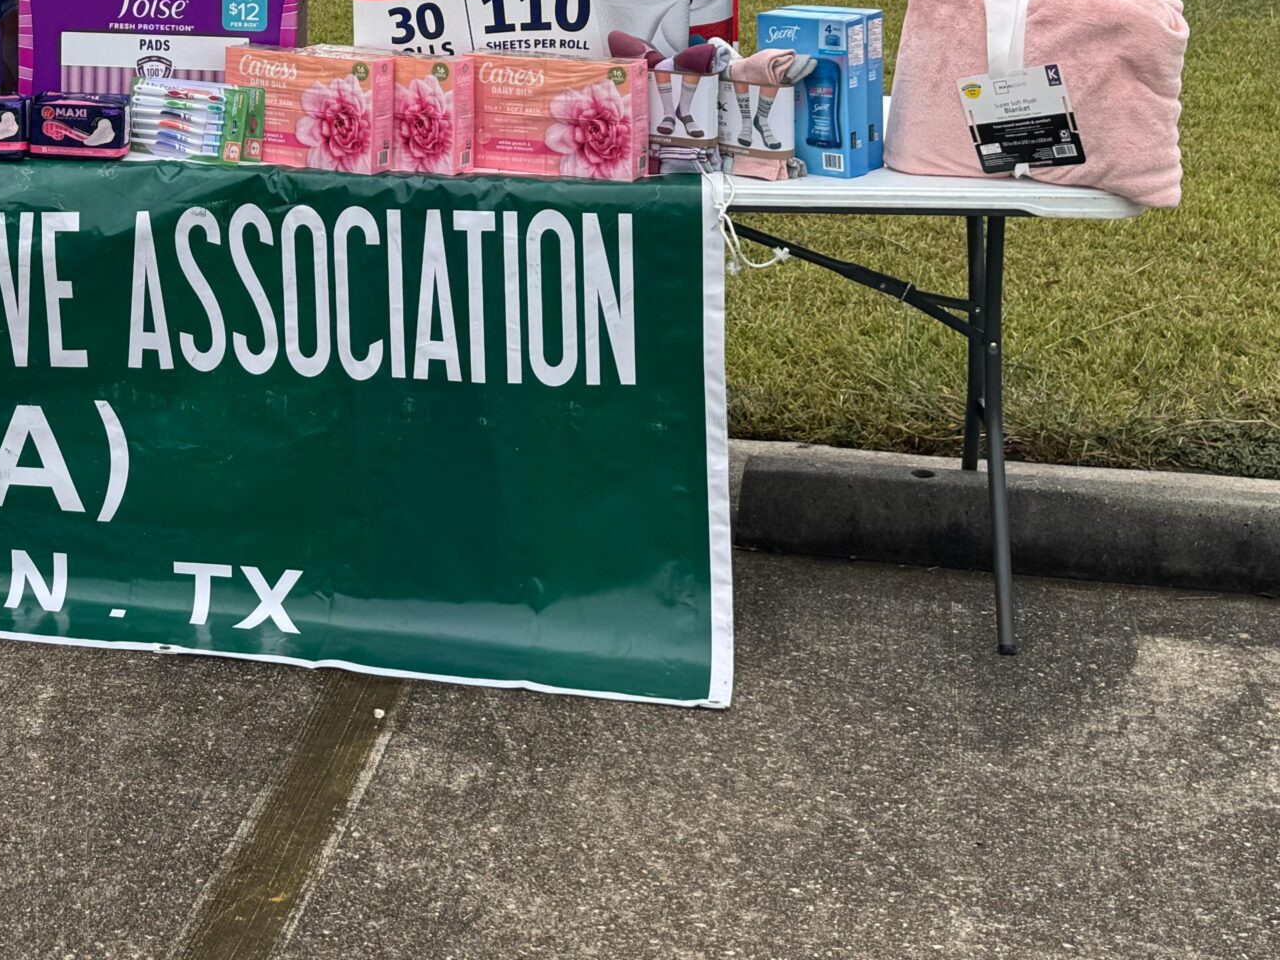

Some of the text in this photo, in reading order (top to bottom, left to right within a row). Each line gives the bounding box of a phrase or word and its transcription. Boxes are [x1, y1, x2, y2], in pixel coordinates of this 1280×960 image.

[229, 3, 259, 21] $12
[137, 23, 192, 31] PROTECTION
[388, 2, 445, 44] 30
[765, 25, 800, 43] Secret
[140, 39, 170, 51] PADS
[486, 39, 590, 51] SHEETS PER ROLL
[239, 54, 298, 80] Caress
[1047, 69, 1057, 79] K
[1004, 105, 1030, 114] Blanket
[127, 204, 636, 386] ASSOCIATION
[174, 561, 304, 634] TX
